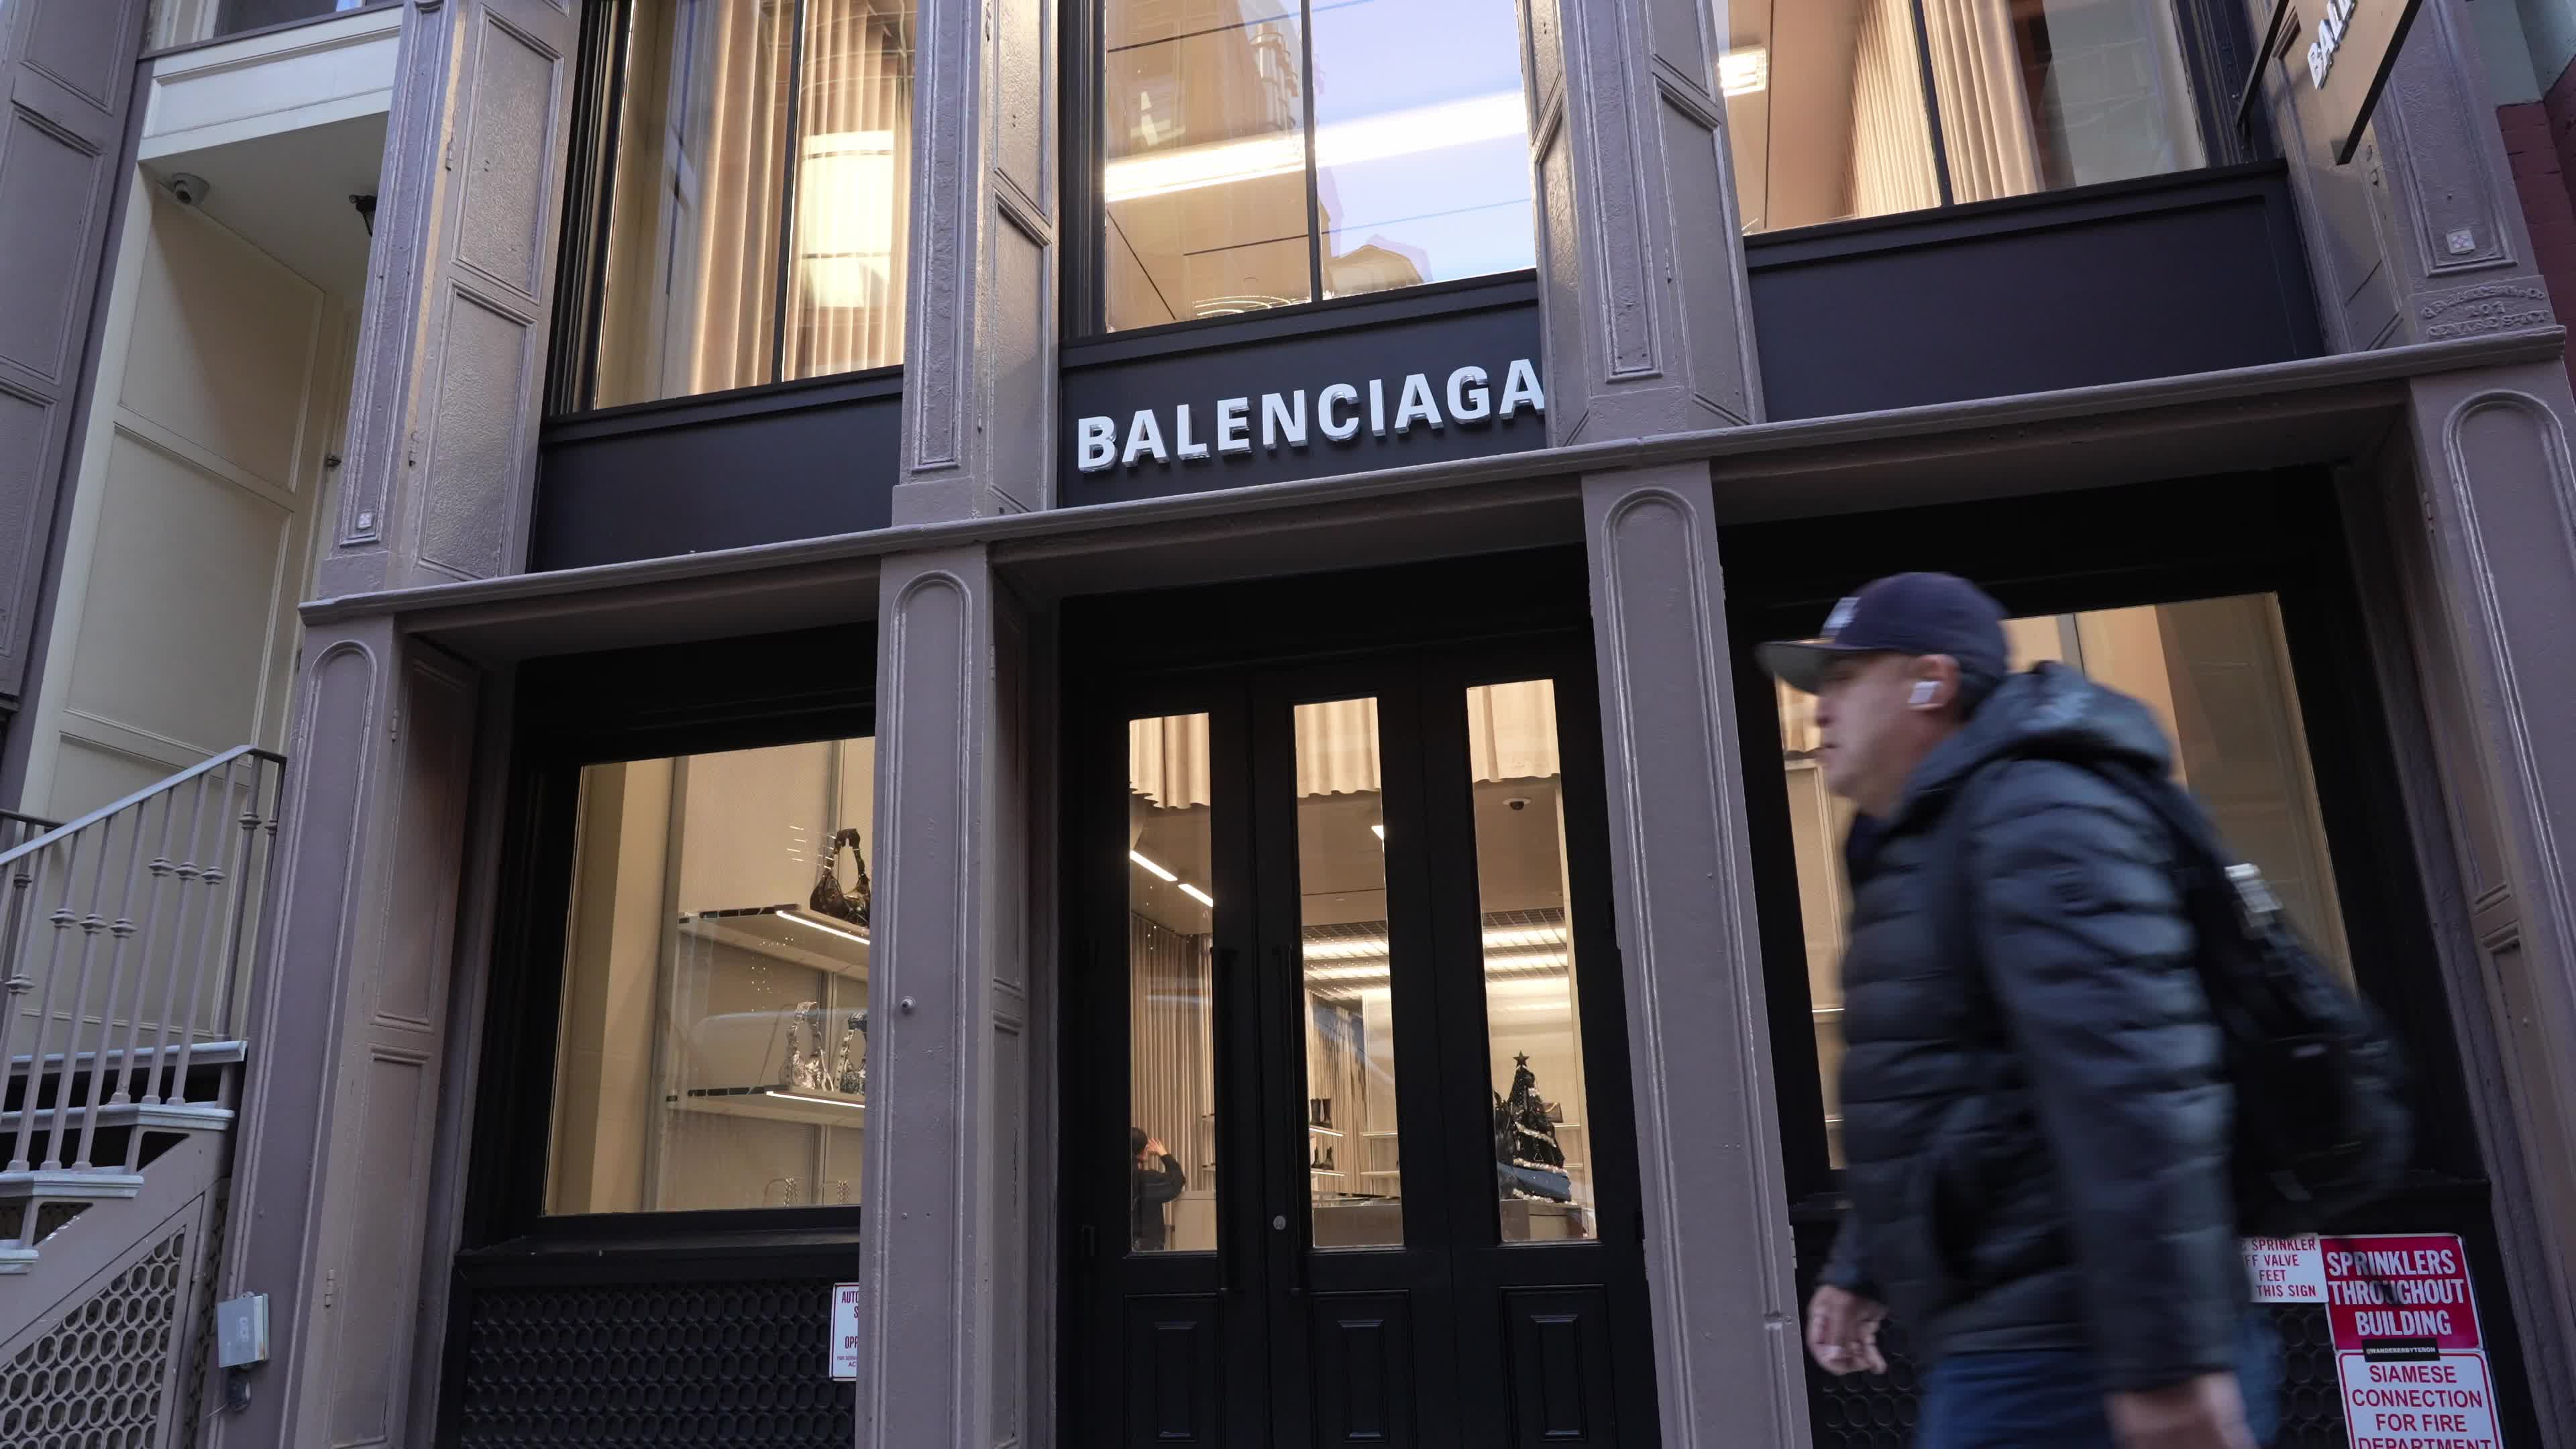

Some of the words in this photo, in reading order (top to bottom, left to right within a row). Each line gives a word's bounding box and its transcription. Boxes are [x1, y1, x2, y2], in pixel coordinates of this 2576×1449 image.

[1078, 359, 1545, 472] BALENCIAGA
[2252, 1238, 2316, 1251] SPRINKLER
[2264, 1254, 2300, 1267] VALVE
[2326, 1249, 2457, 1277] SPRINKLERS
[2259, 1269, 2286, 1282] FEET
[2257, 1285, 2284, 1297] THIS
[2288, 1285, 2316, 1297] SIGN
[2355, 1309, 2453, 1336] BUILDING
[2369, 1364, 2458, 1384] SIAMESE
[2352, 1389, 2483, 1407] CONNECTION
[2375, 1413, 2417, 1432] FOR
[2422, 1414, 2468, 1433] FIRE
